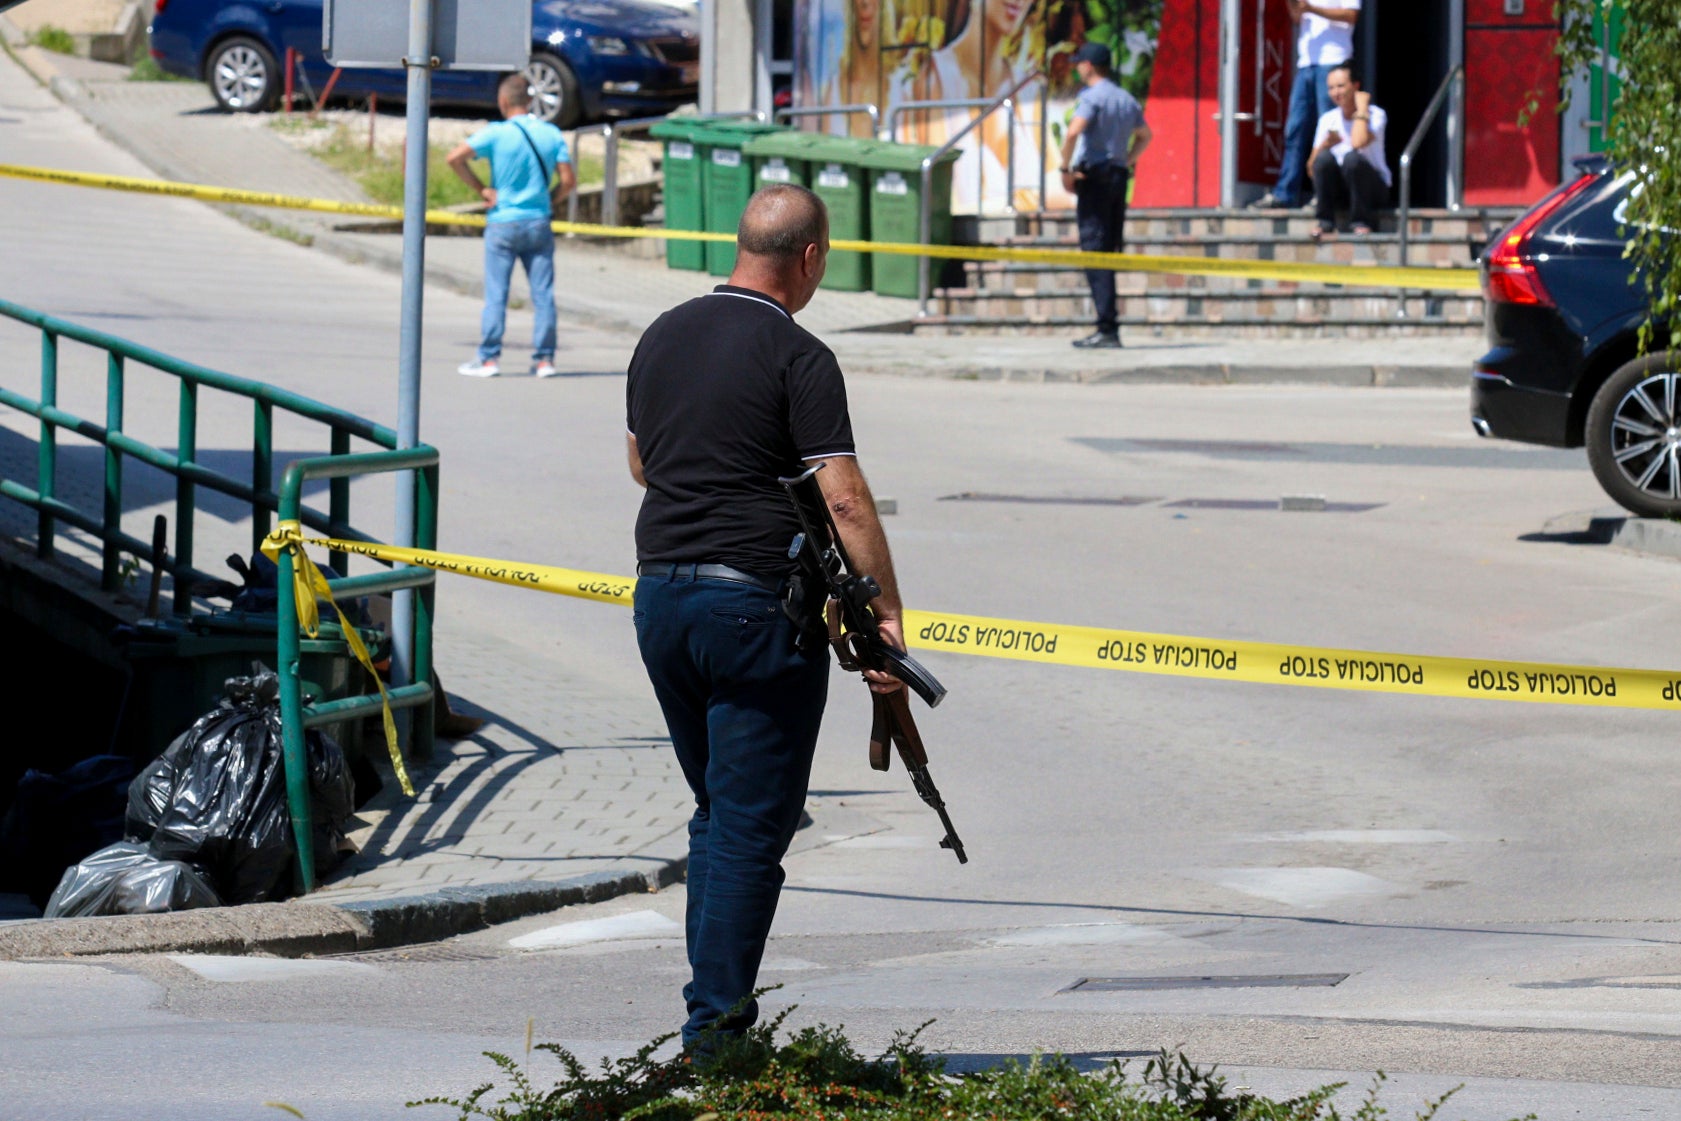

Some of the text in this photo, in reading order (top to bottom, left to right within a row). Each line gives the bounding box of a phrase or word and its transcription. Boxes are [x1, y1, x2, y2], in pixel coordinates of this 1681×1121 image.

[1264, 38, 1284, 175] IZLAZ
[919, 622, 1058, 653] POLICIJA STOP
[1097, 640, 1237, 671] POLICIJA STOP
[1279, 655, 1424, 685] POLICIJA STOP
[1467, 669, 1617, 697] POLICIJA STOP
